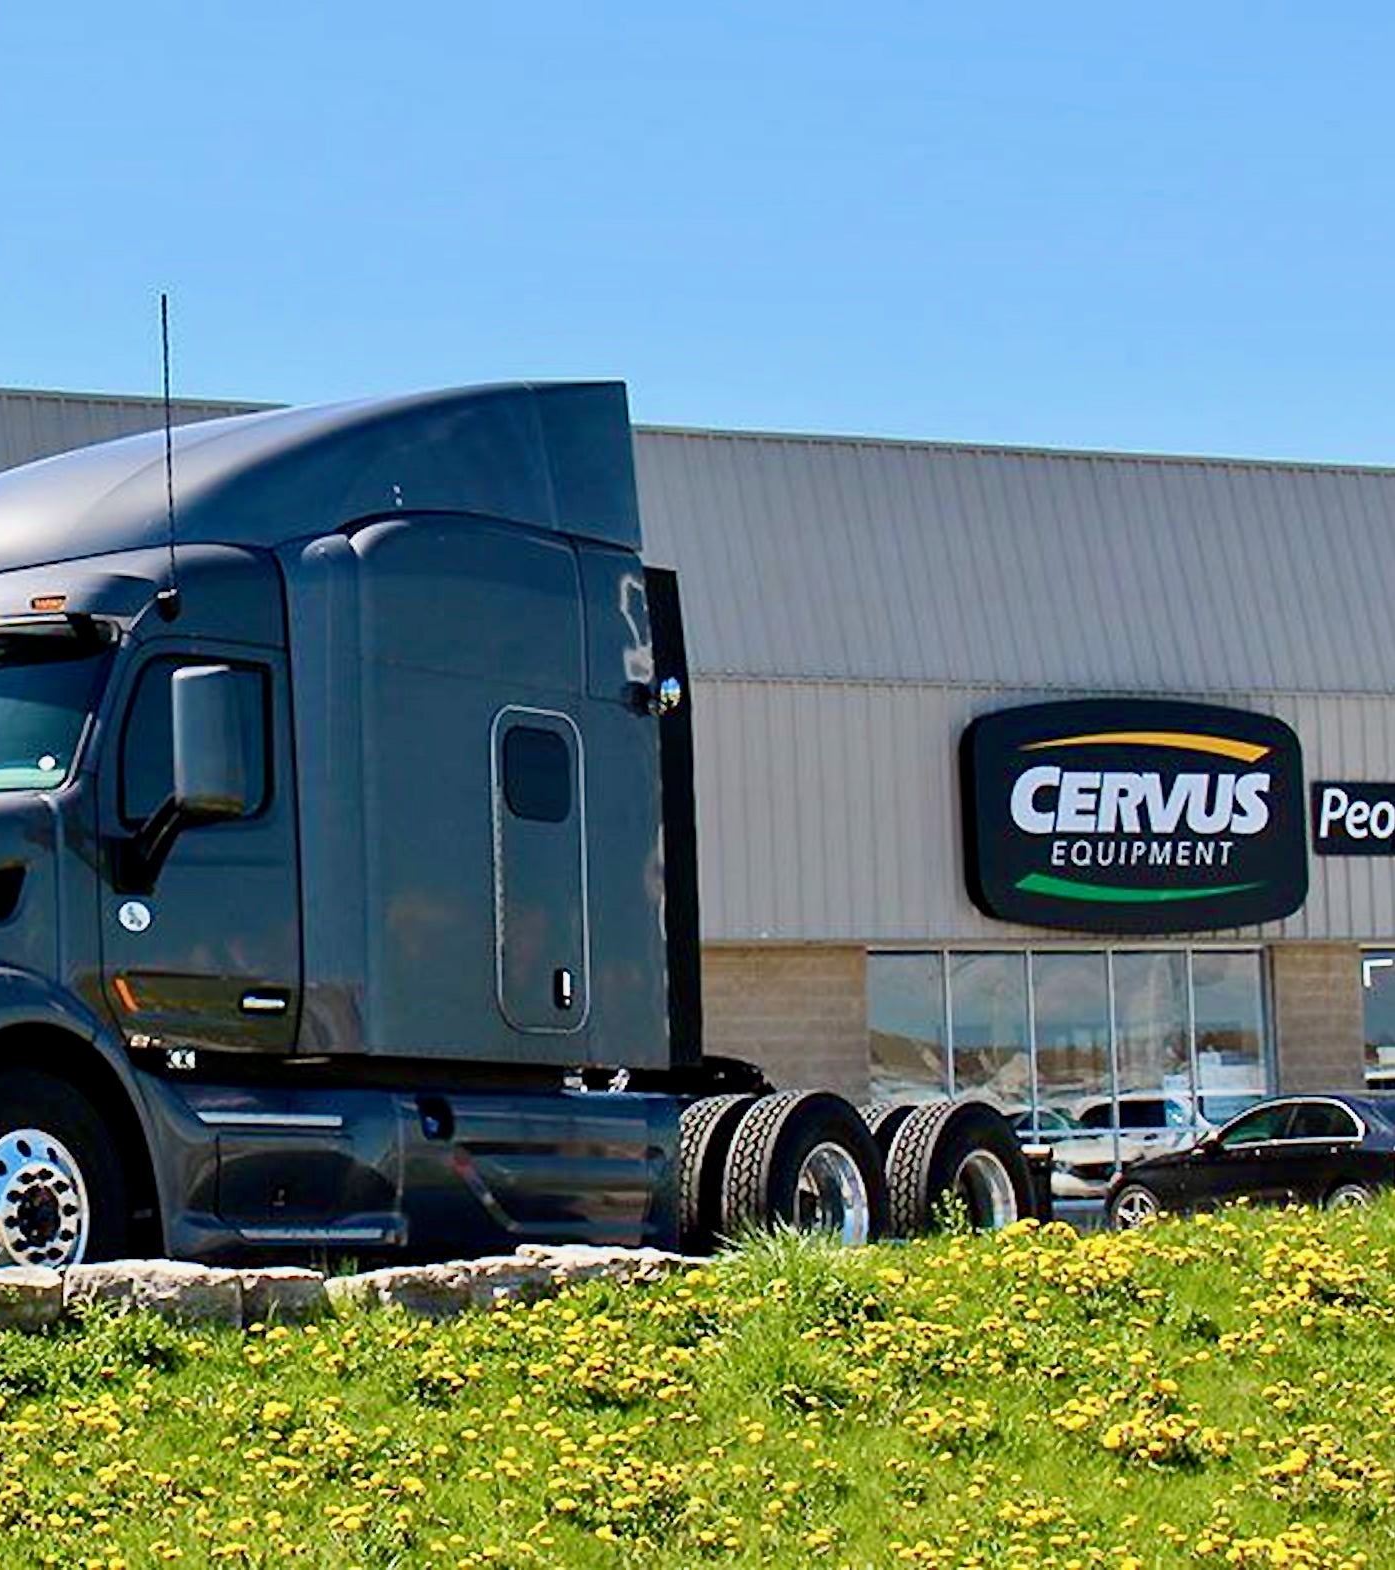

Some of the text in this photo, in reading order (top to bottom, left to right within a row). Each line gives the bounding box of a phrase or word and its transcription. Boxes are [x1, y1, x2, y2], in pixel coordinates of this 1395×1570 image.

[1010, 766, 1270, 834] CERVUS
[1319, 787, 1395, 839] Peo
[1051, 840, 1233, 867] EQUIPMENT
